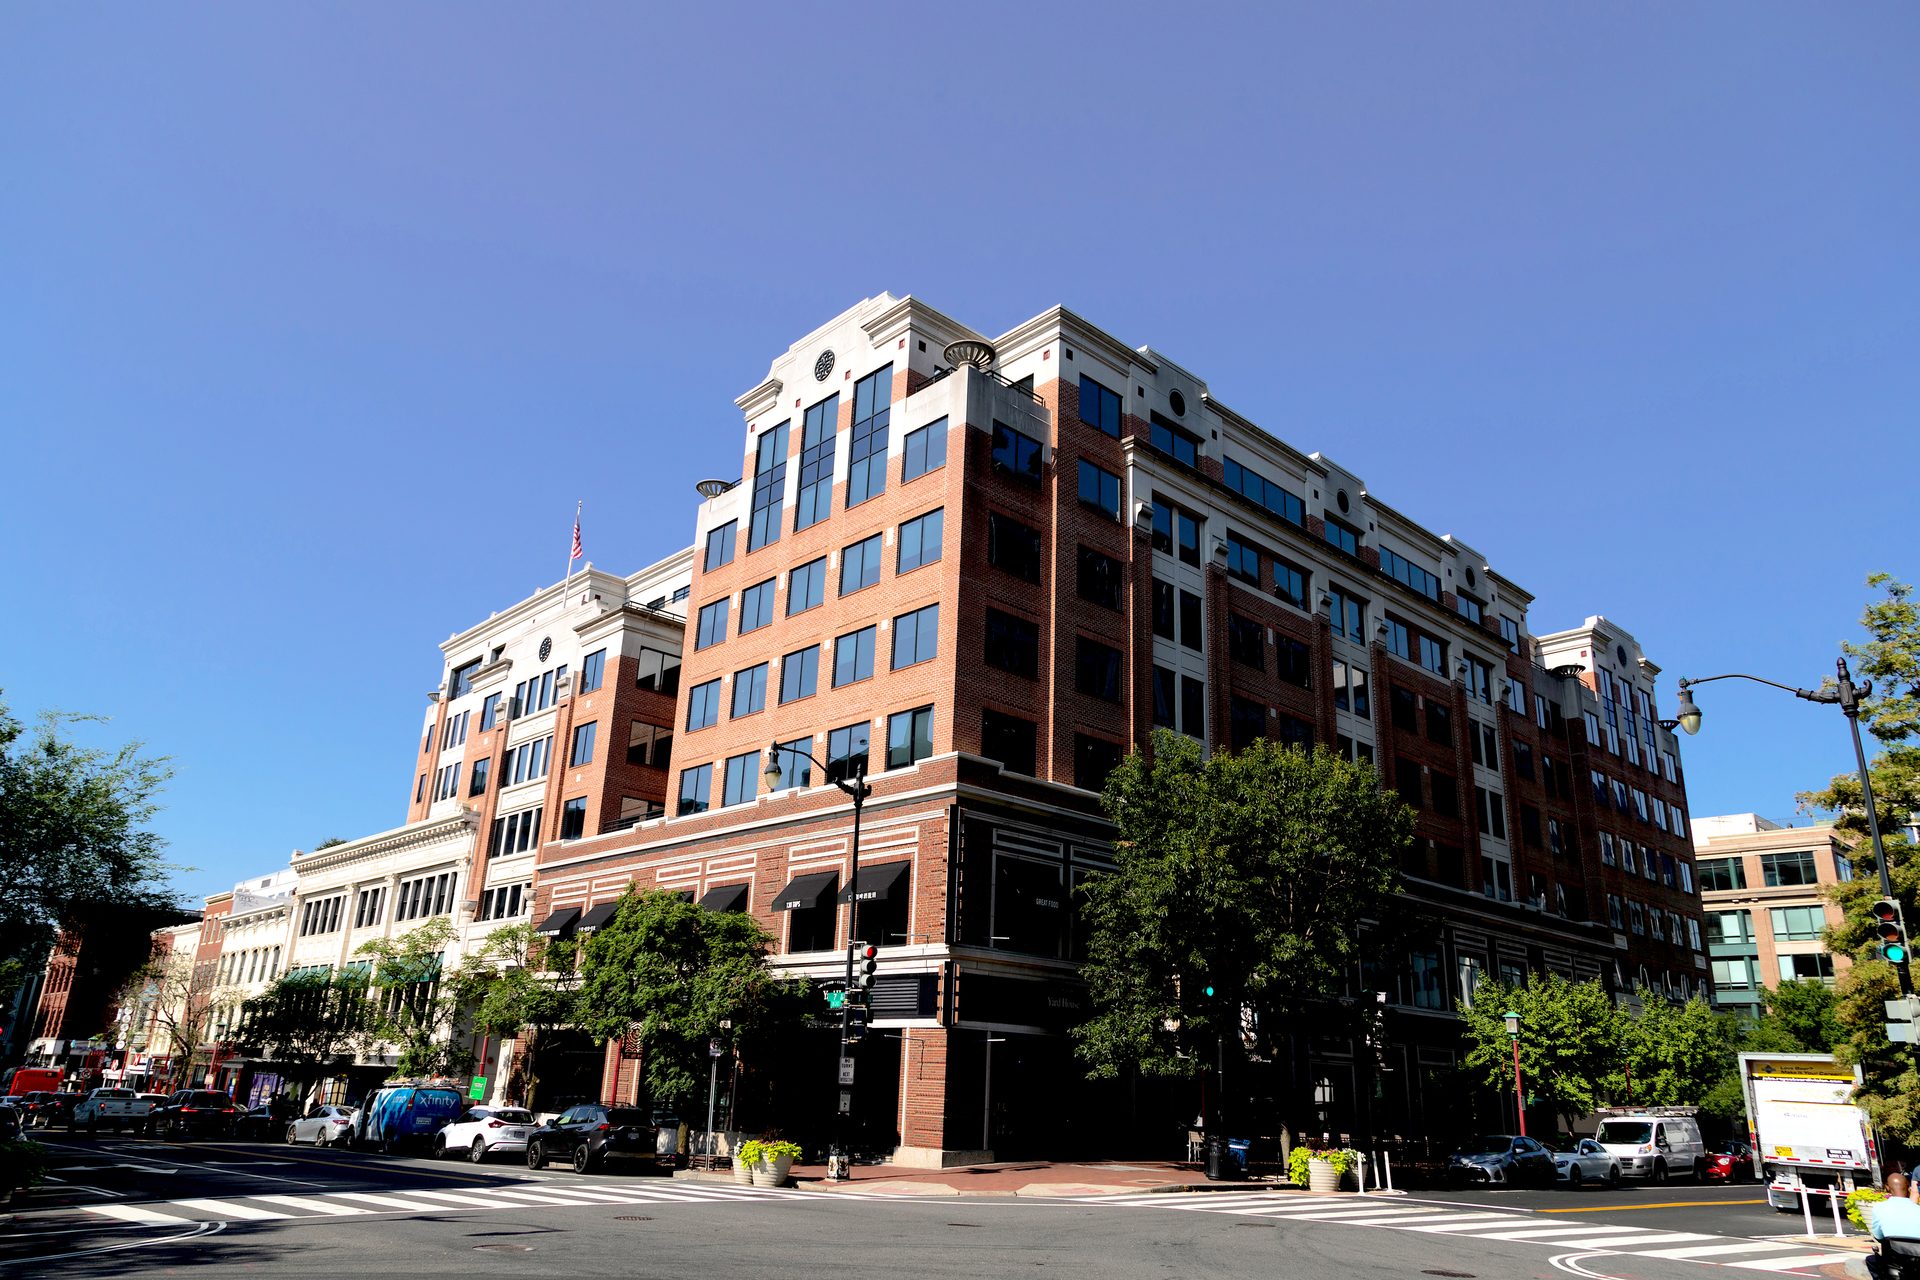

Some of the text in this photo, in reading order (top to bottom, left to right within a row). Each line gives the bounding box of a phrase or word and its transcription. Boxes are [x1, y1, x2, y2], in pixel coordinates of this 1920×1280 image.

[1036, 898, 1059, 909] GREAT FOOD
[1048, 996, 1061, 1007] Yard
[420, 1094, 456, 1108] xfinity
